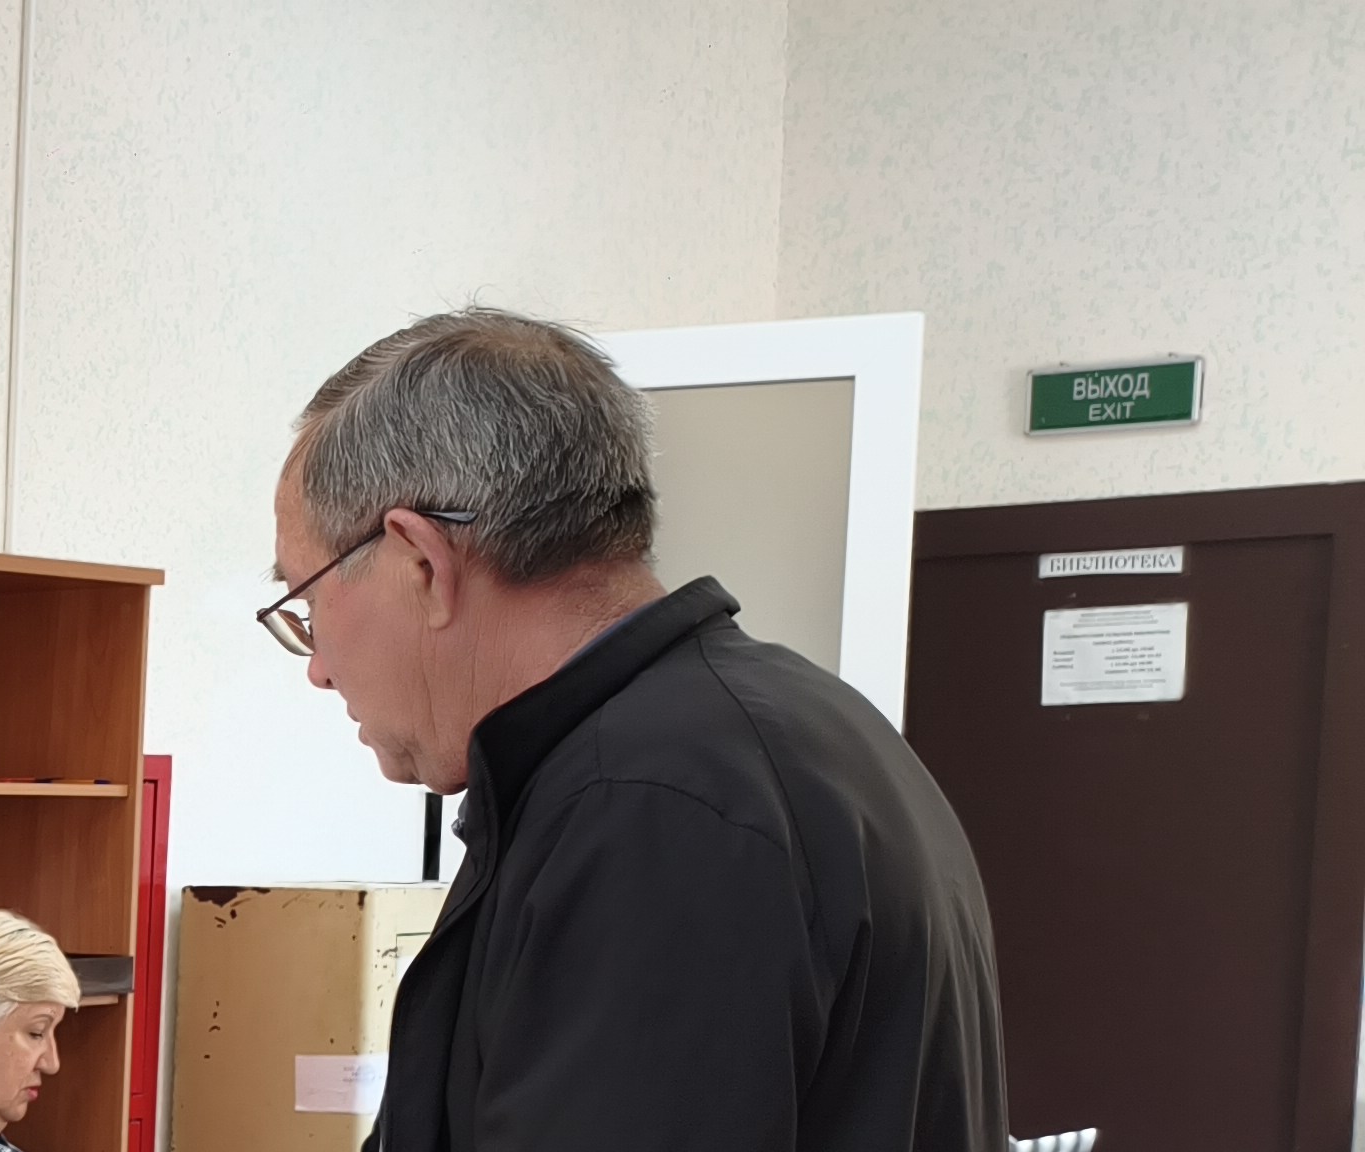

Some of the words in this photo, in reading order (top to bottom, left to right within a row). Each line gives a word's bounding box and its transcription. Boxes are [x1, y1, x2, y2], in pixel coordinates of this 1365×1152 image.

[1072, 373, 1150, 400] ВЫХОД
[1088, 402, 1135, 421] EXIT
[1050, 554, 1176, 572] БИБЛИОТЕКА
